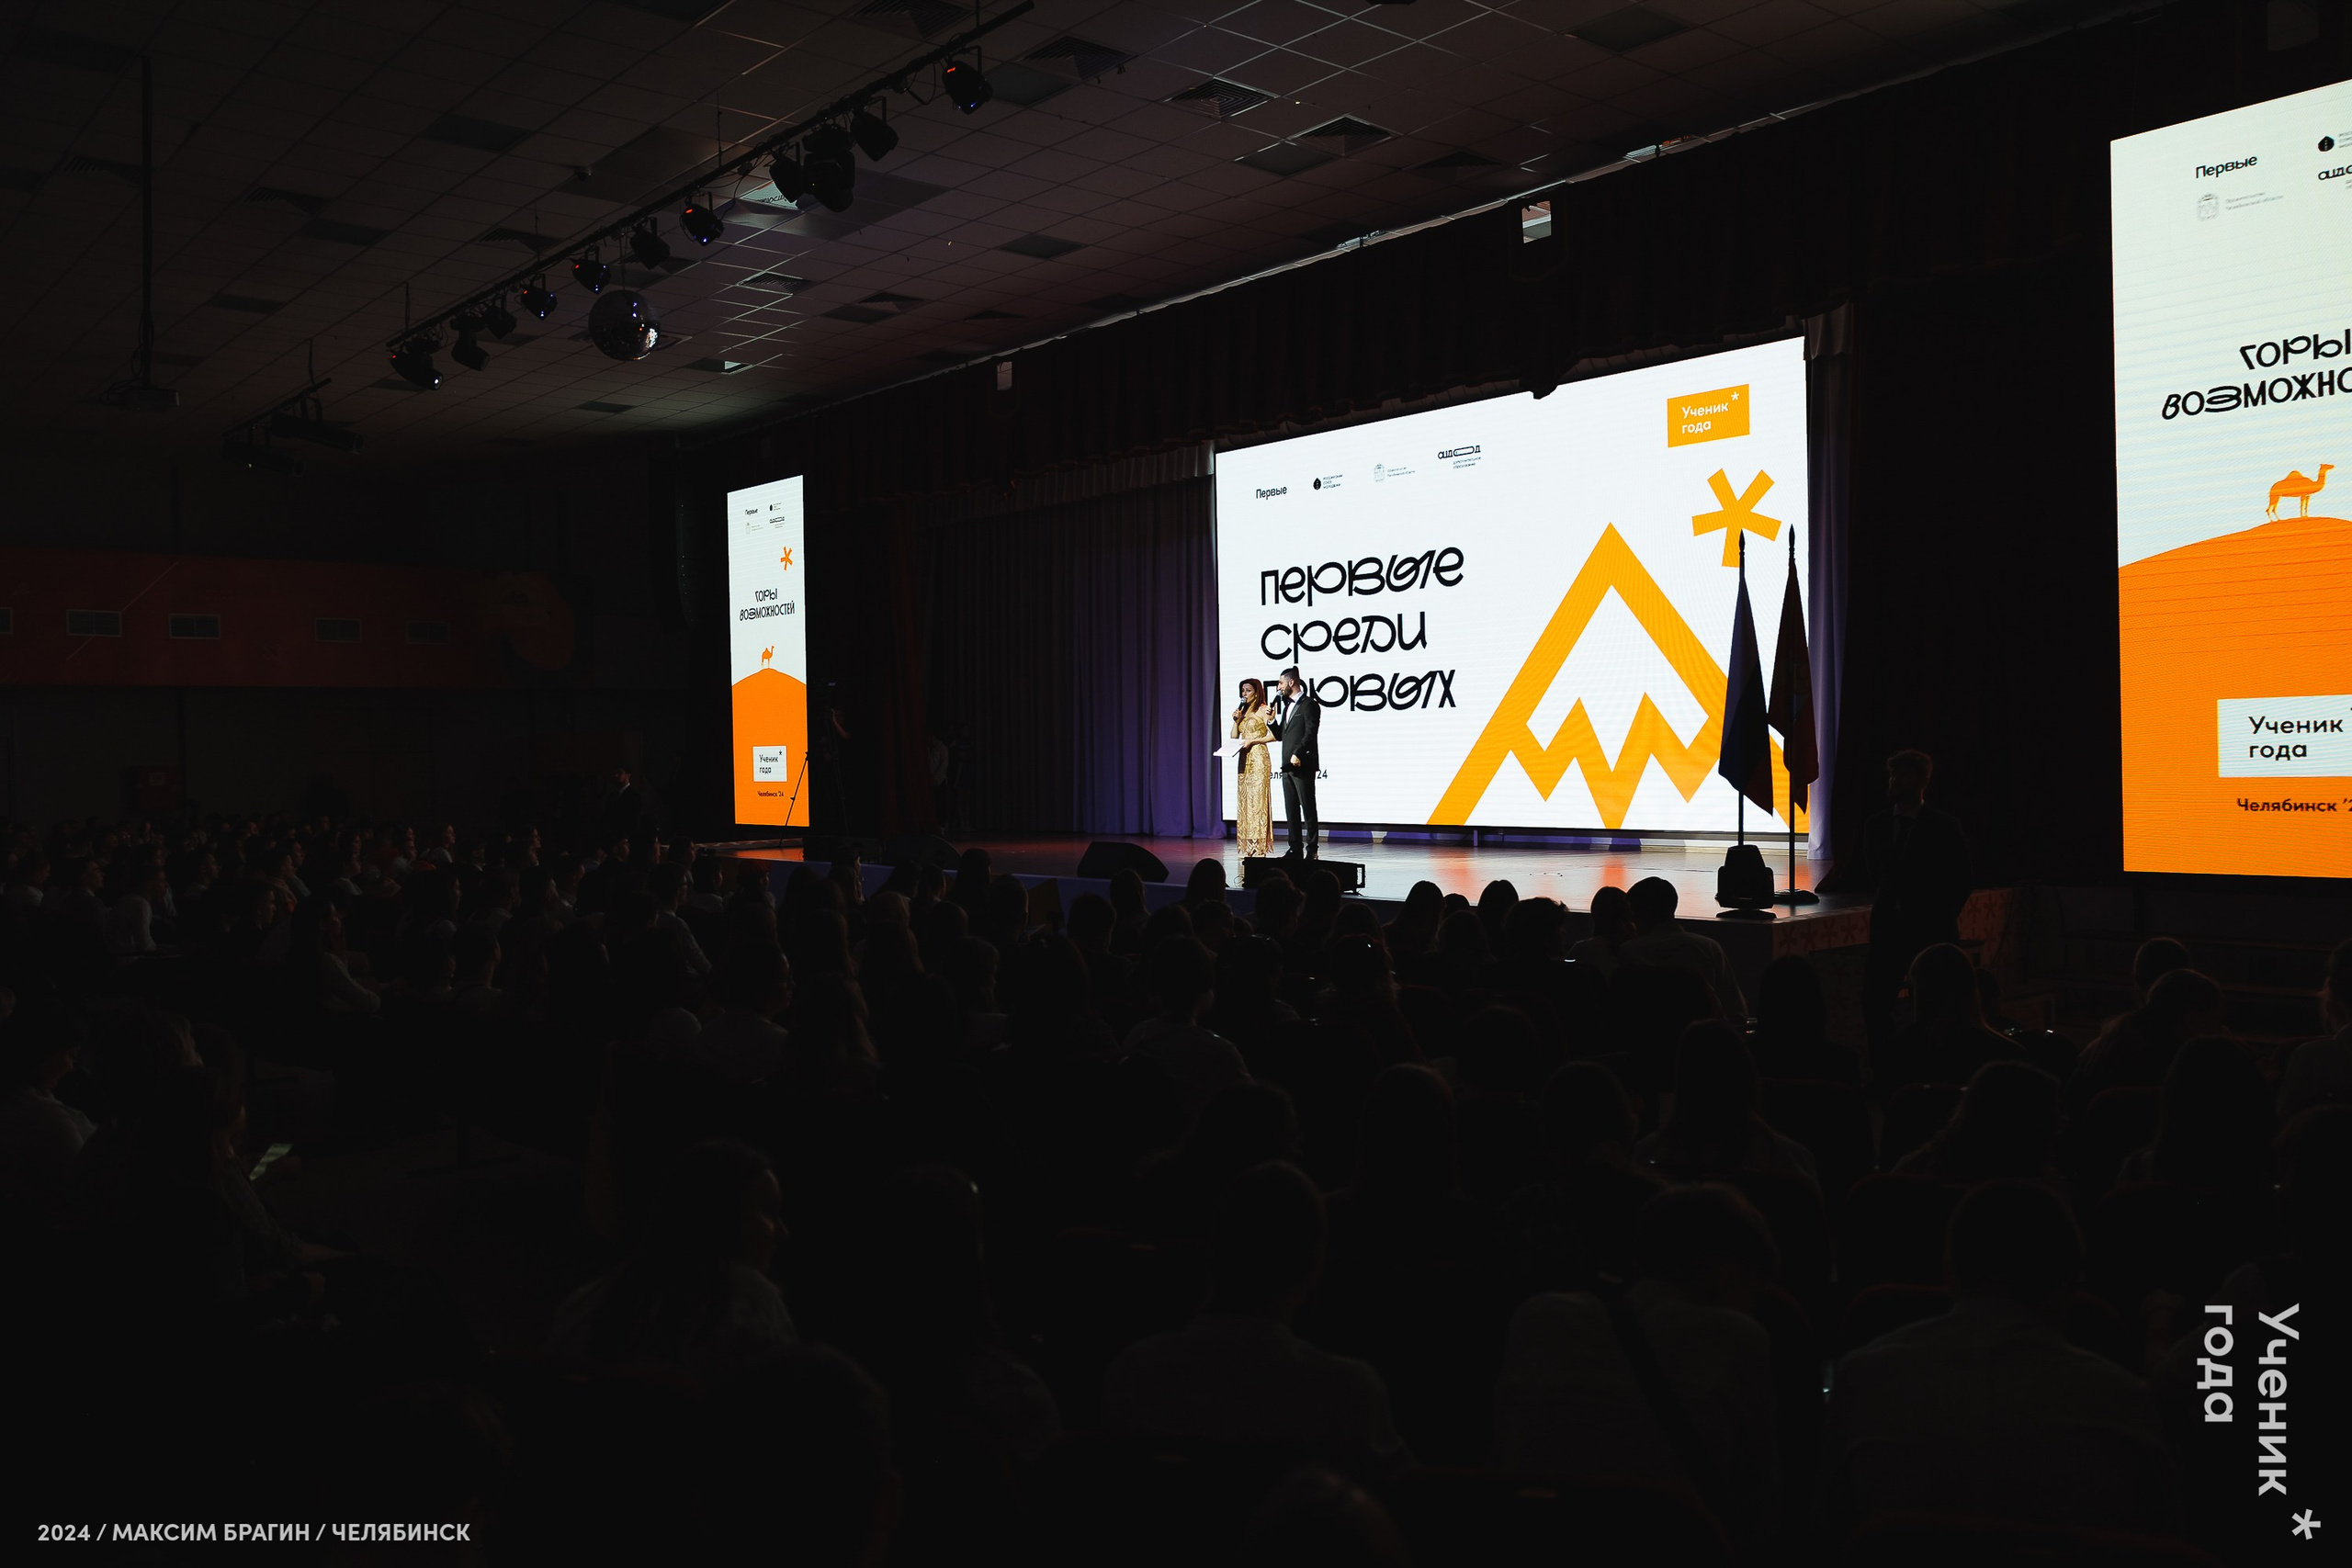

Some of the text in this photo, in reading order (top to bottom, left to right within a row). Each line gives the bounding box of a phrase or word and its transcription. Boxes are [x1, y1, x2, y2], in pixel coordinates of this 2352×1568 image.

[2195, 156, 2258, 179] Первые
[1681, 402, 1729, 419] Ученик
[1681, 421, 1712, 434] года
[1256, 485, 1287, 500] Первые
[2248, 716, 2344, 735] Ученик
[759, 754, 779, 763] Ученик
[2249, 744, 2307, 761] года
[759, 766, 772, 774] года
[2236, 797, 2337, 812] Челябинск
